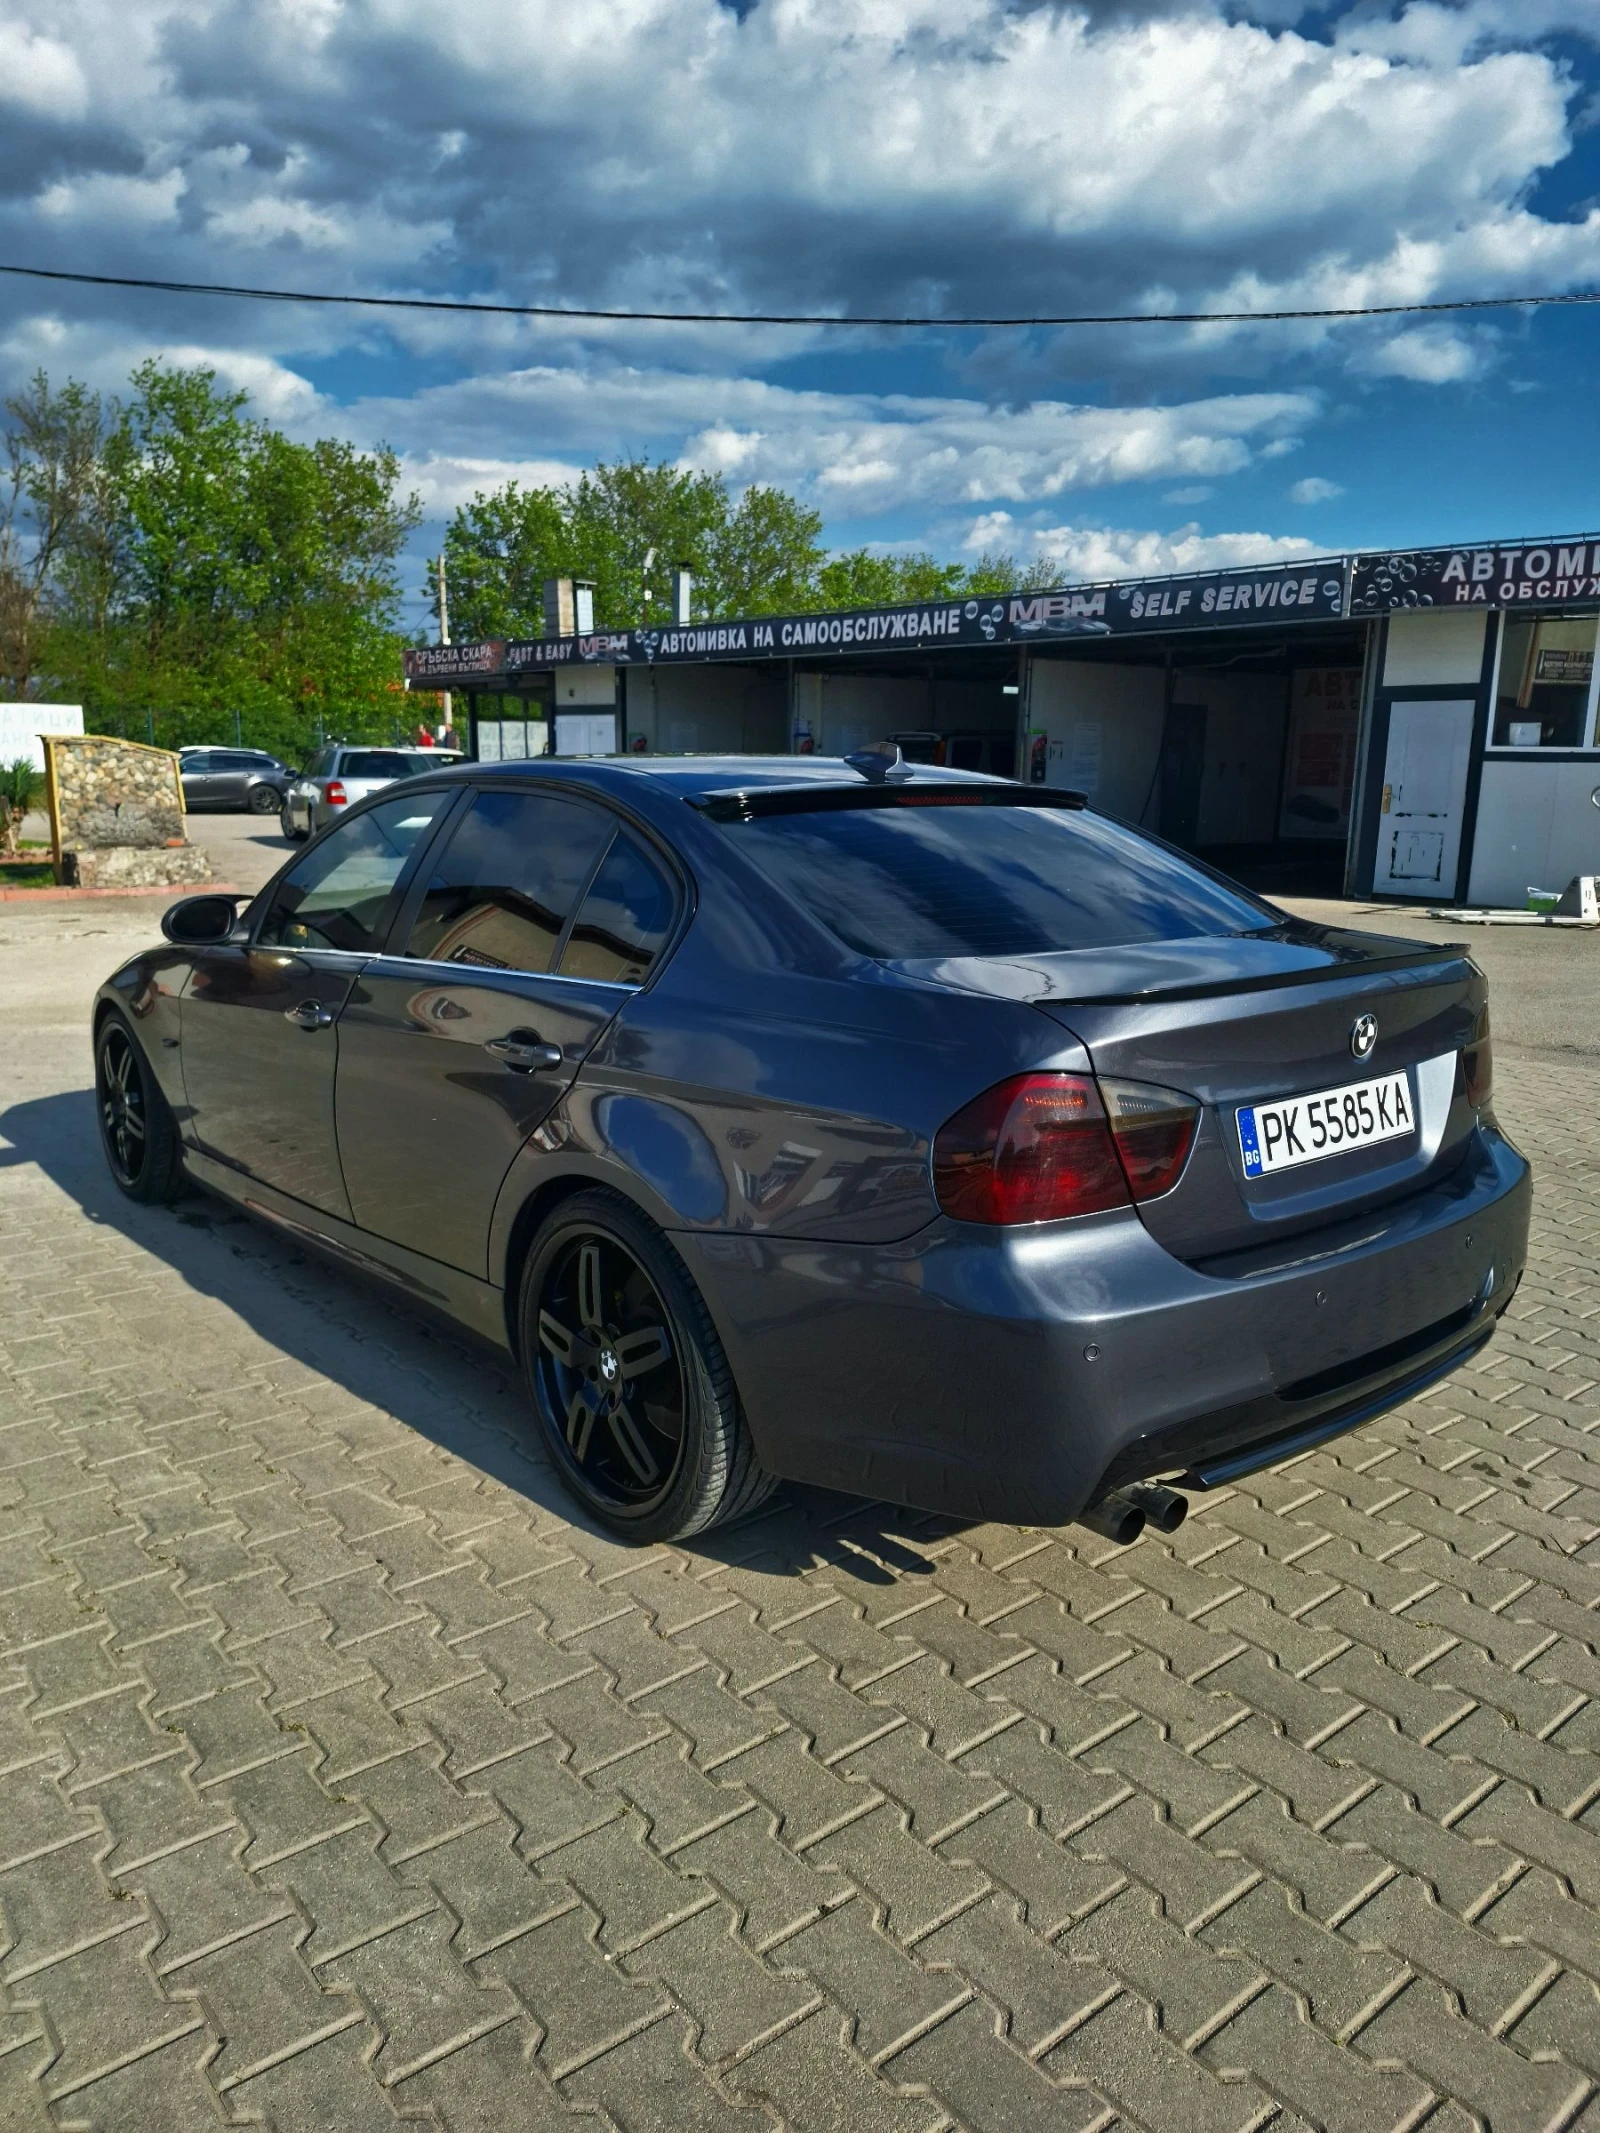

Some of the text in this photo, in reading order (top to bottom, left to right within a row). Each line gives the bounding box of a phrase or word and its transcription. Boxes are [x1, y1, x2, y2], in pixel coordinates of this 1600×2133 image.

[1130, 589, 1192, 619] SELF
[1200, 578, 1319, 613] SERVICE
[1455, 583, 1487, 601] НА
[660, 608, 961, 654] АВТОМИВКА НА САМООБСЛУЖВАНЕ
[415, 644, 493, 665] СРЪБСКА СКАРА
[509, 645, 533, 662] FAST
[545, 643, 573, 660] EASY
[1245, 1150, 1260, 1166] BG
